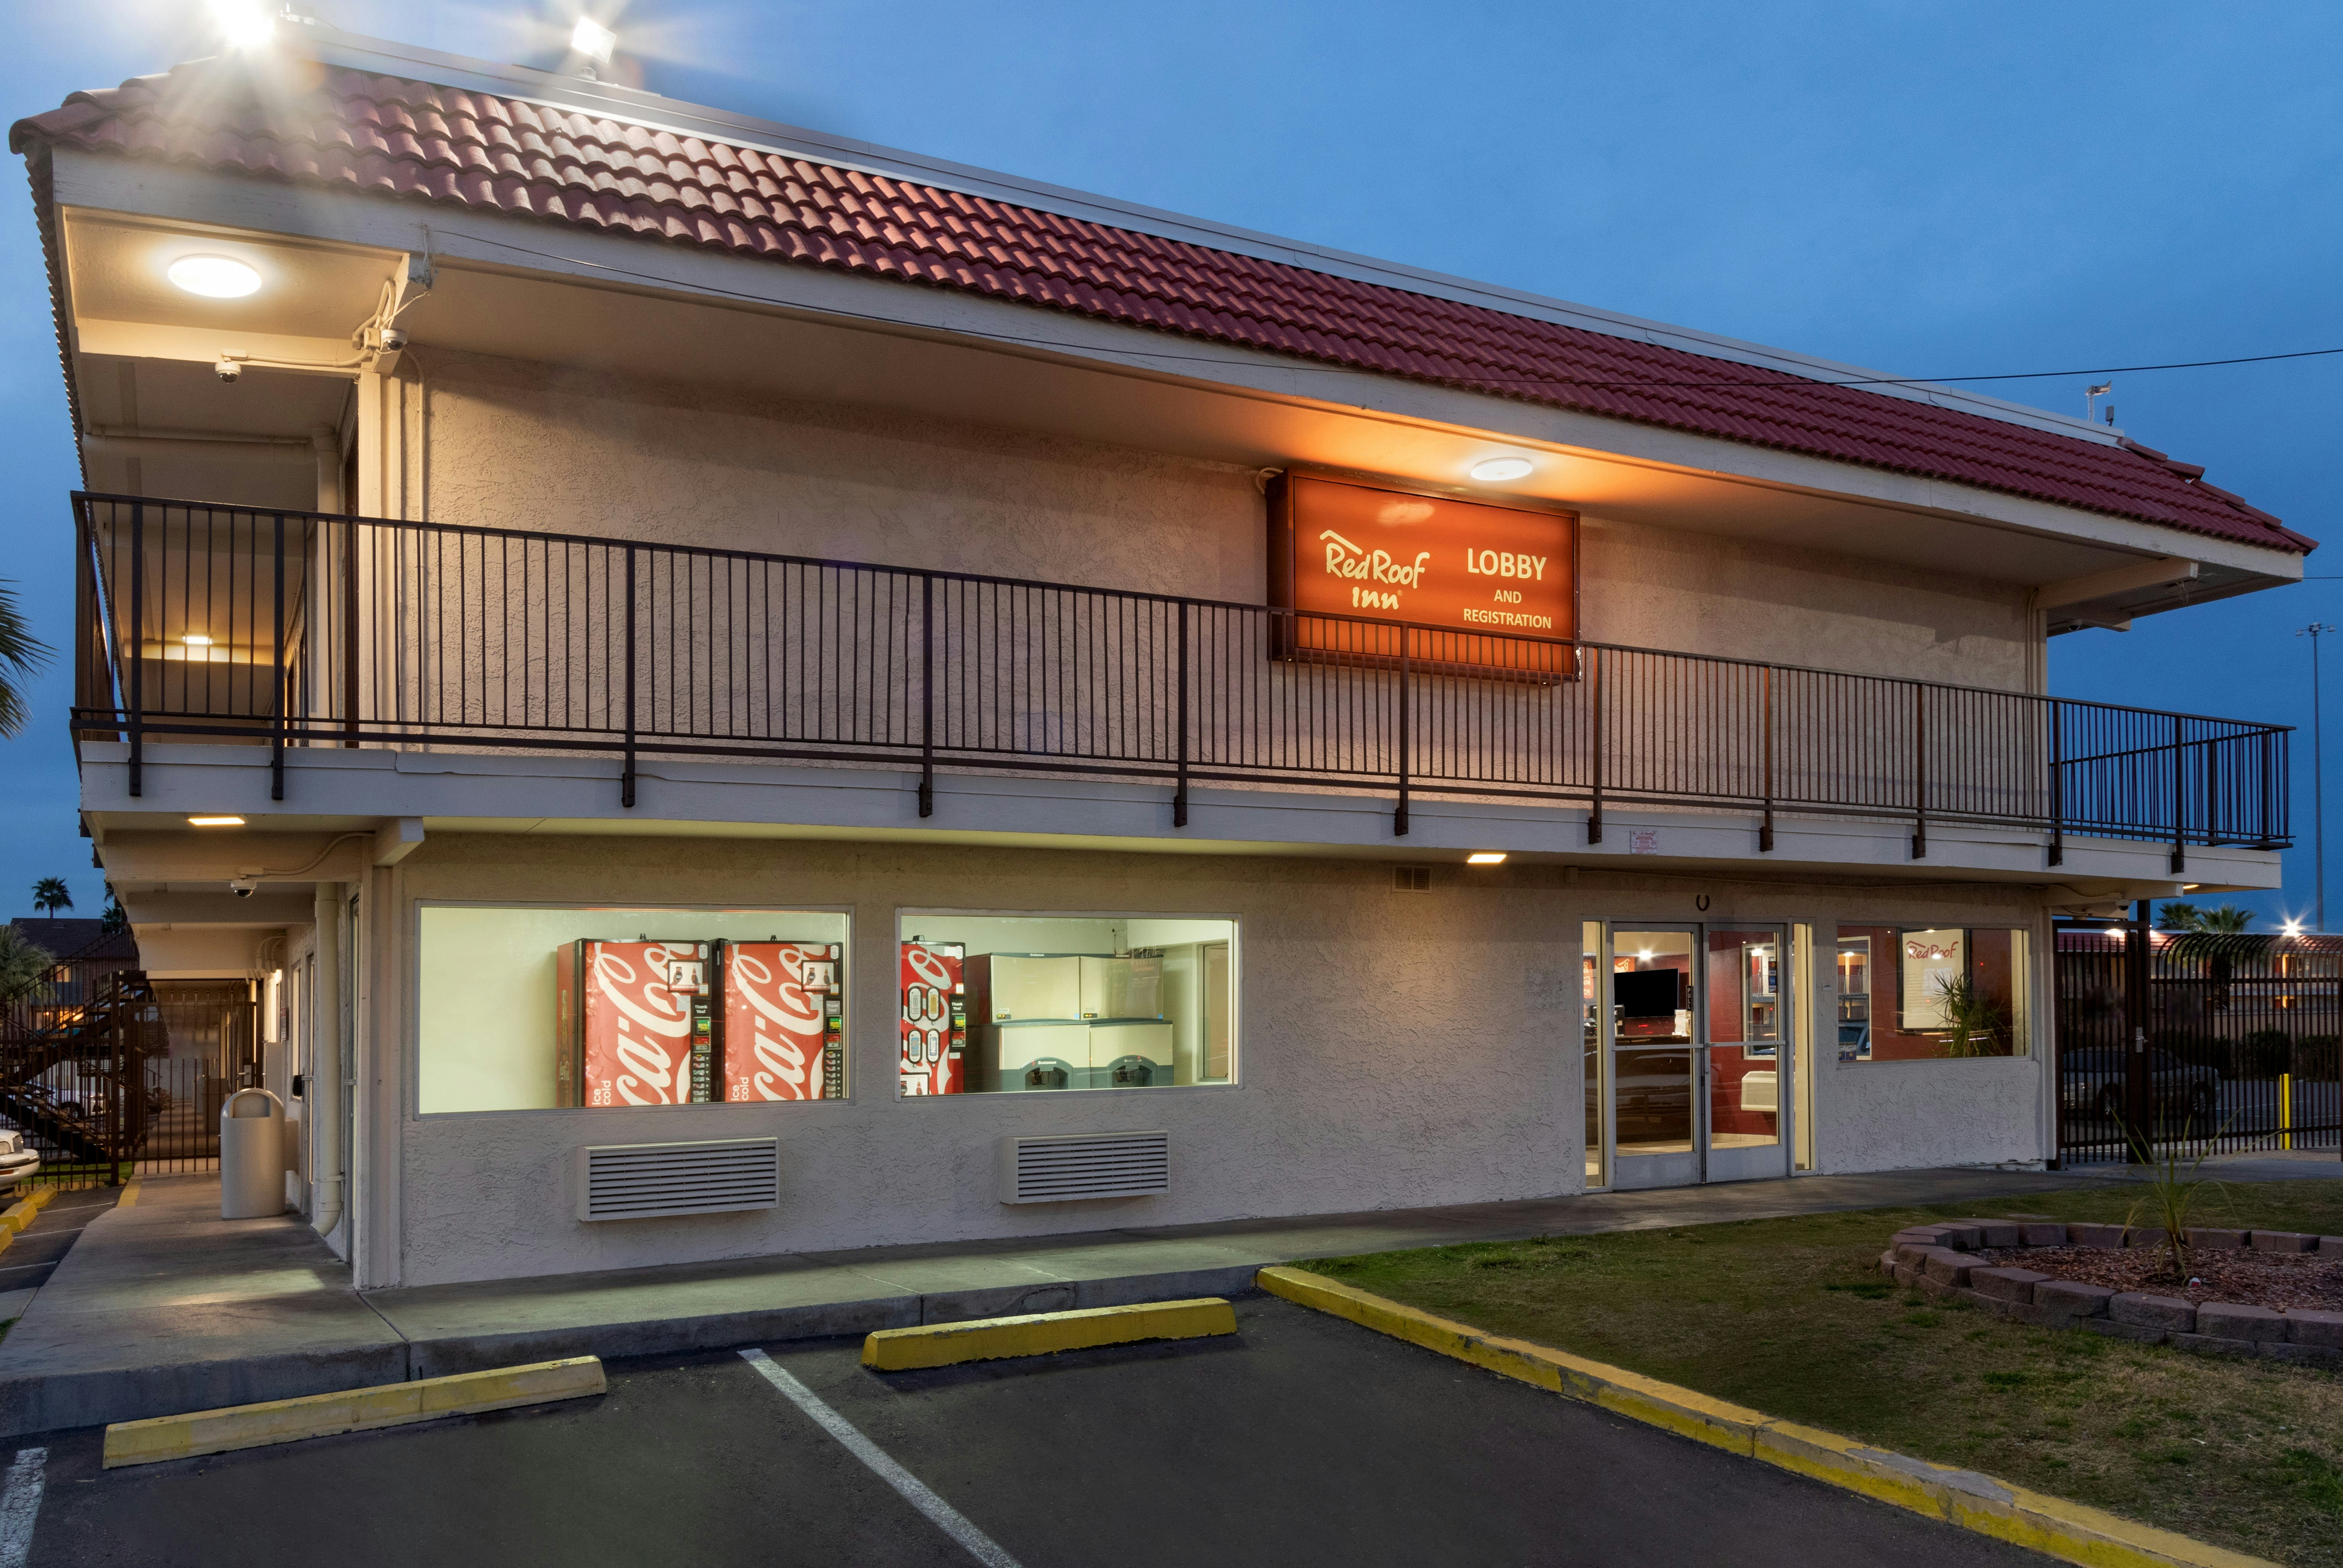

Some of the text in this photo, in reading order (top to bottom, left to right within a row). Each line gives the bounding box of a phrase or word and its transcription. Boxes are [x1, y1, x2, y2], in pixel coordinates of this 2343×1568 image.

[1468, 548, 1547, 580] LOBBY
[1352, 586, 1399, 610] Inn
[1494, 589, 1522, 603] AND
[1463, 608, 1551, 629] REGISTRATION
[592, 1088, 601, 1105] ice
[601, 1080, 611, 1105] cold
[730, 1085, 740, 1101] ice
[739, 1077, 749, 1101] cold
